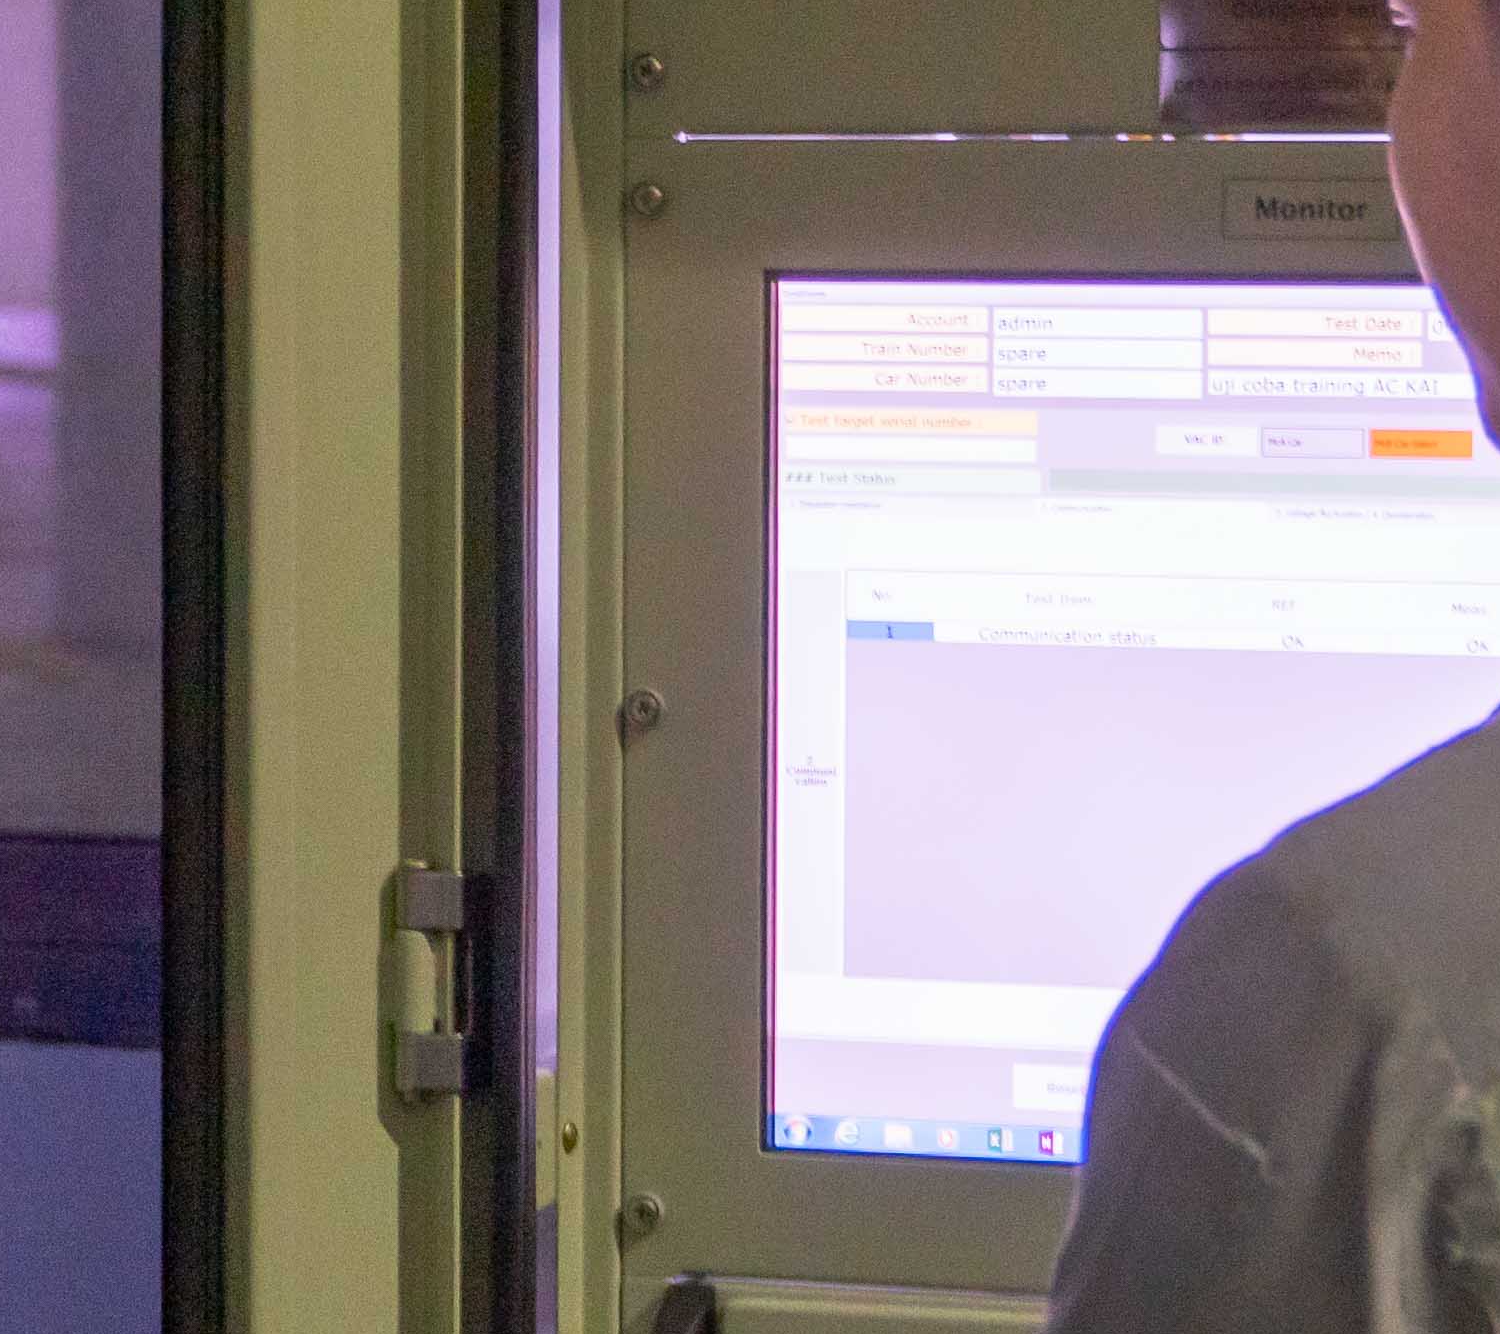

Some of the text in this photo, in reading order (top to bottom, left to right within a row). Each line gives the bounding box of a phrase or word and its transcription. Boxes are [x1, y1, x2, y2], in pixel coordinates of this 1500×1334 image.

[1255, 195, 1368, 222] Monitor
[906, 313, 970, 328] Account
[997, 315, 1054, 332] admin
[1325, 316, 1402, 333] Test Date
[861, 341, 969, 358] Train Number
[997, 347, 1048, 364] spare
[1353, 346, 1402, 363] Memo
[873, 372, 969, 388] Car Number
[997, 376, 1048, 393] spare
[1211, 376, 1440, 397] uji coba training AC KAI
[818, 470, 849, 485] Test
[977, 626, 1158, 647] Communication status
